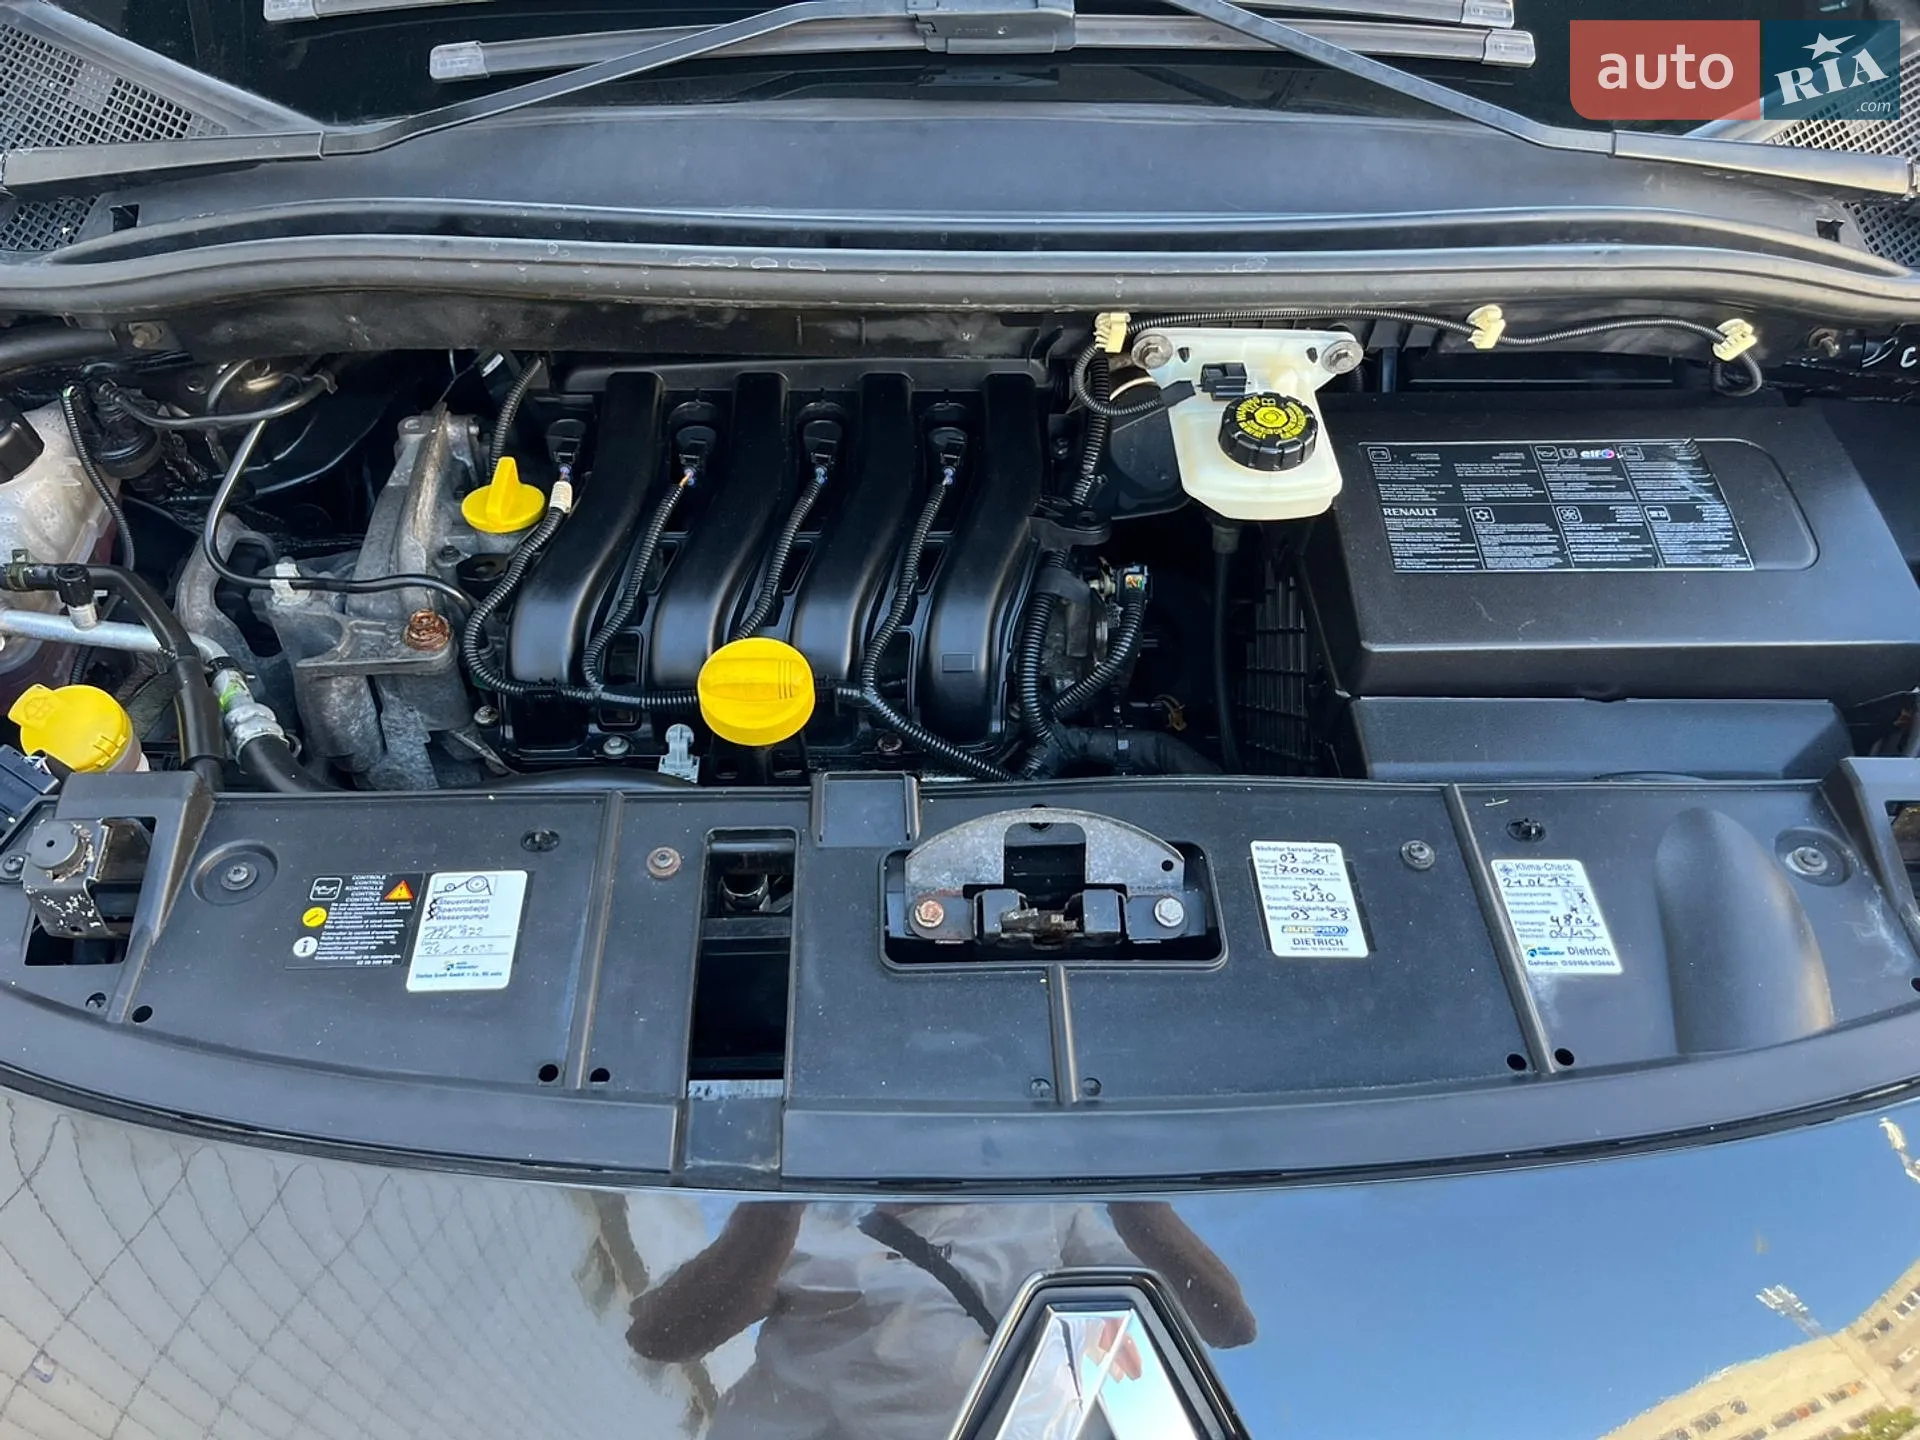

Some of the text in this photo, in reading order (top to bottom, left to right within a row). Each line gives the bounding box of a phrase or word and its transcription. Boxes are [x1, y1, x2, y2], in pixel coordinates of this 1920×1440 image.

[1382, 508, 1438, 516] RENAULT
[1292, 938, 1344, 946] DIETRICH
[1567, 946, 1611, 956] Dietrich
